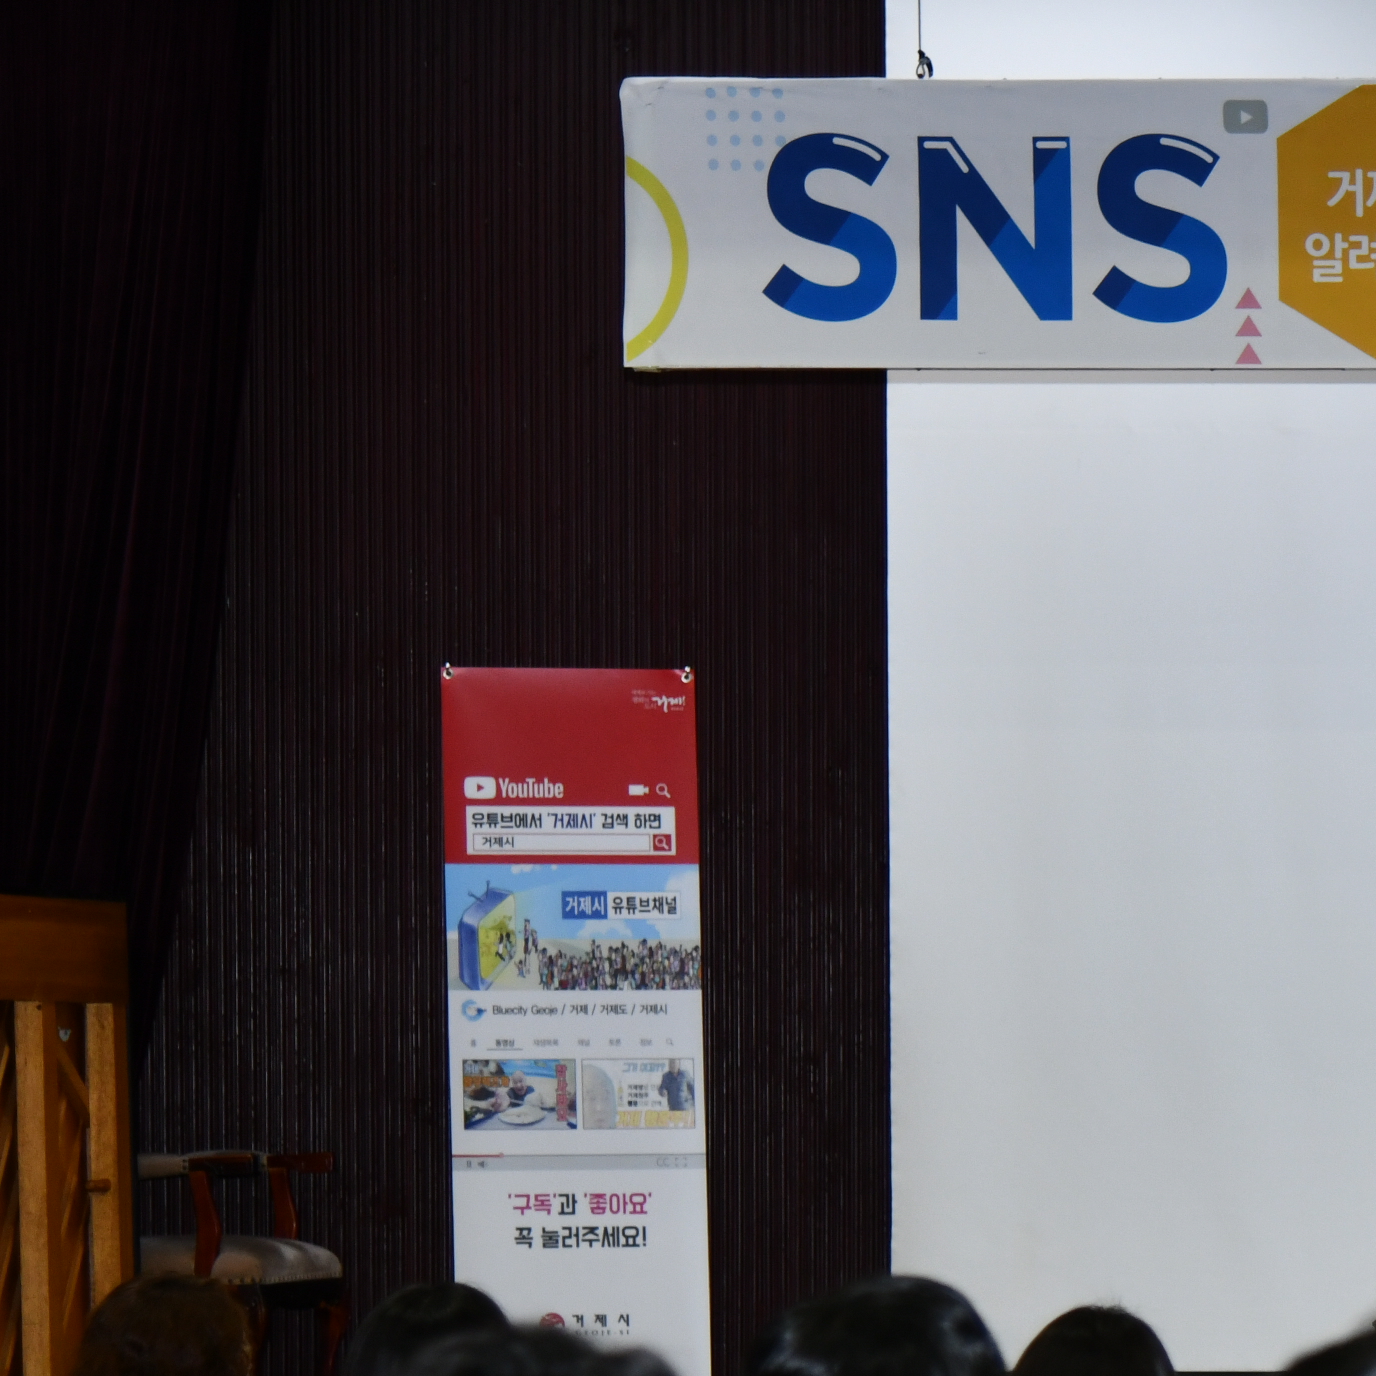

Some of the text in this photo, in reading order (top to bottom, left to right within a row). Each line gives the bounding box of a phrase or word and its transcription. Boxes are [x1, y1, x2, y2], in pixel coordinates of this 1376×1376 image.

[762, 132, 1228, 323] SNS
[498, 777, 564, 799] YouTube
[471, 812, 662, 829] 유튜브에서 '거제시' 검색 하면
[482, 836, 515, 848] 거제시
[565, 896, 678, 916] 거제시 유튜브채널
[492, 1004, 528, 1017] Bluecity
[531, 1004, 558, 1017] Geoje
[569, 1003, 588, 1015] 거제
[600, 1003, 628, 1015] 거제도
[639, 1003, 668, 1015] 거제시
[508, 1191, 652, 1216] '구독'과 '좋아요'
[514, 1225, 647, 1249] 꼭 눌러주세요!
